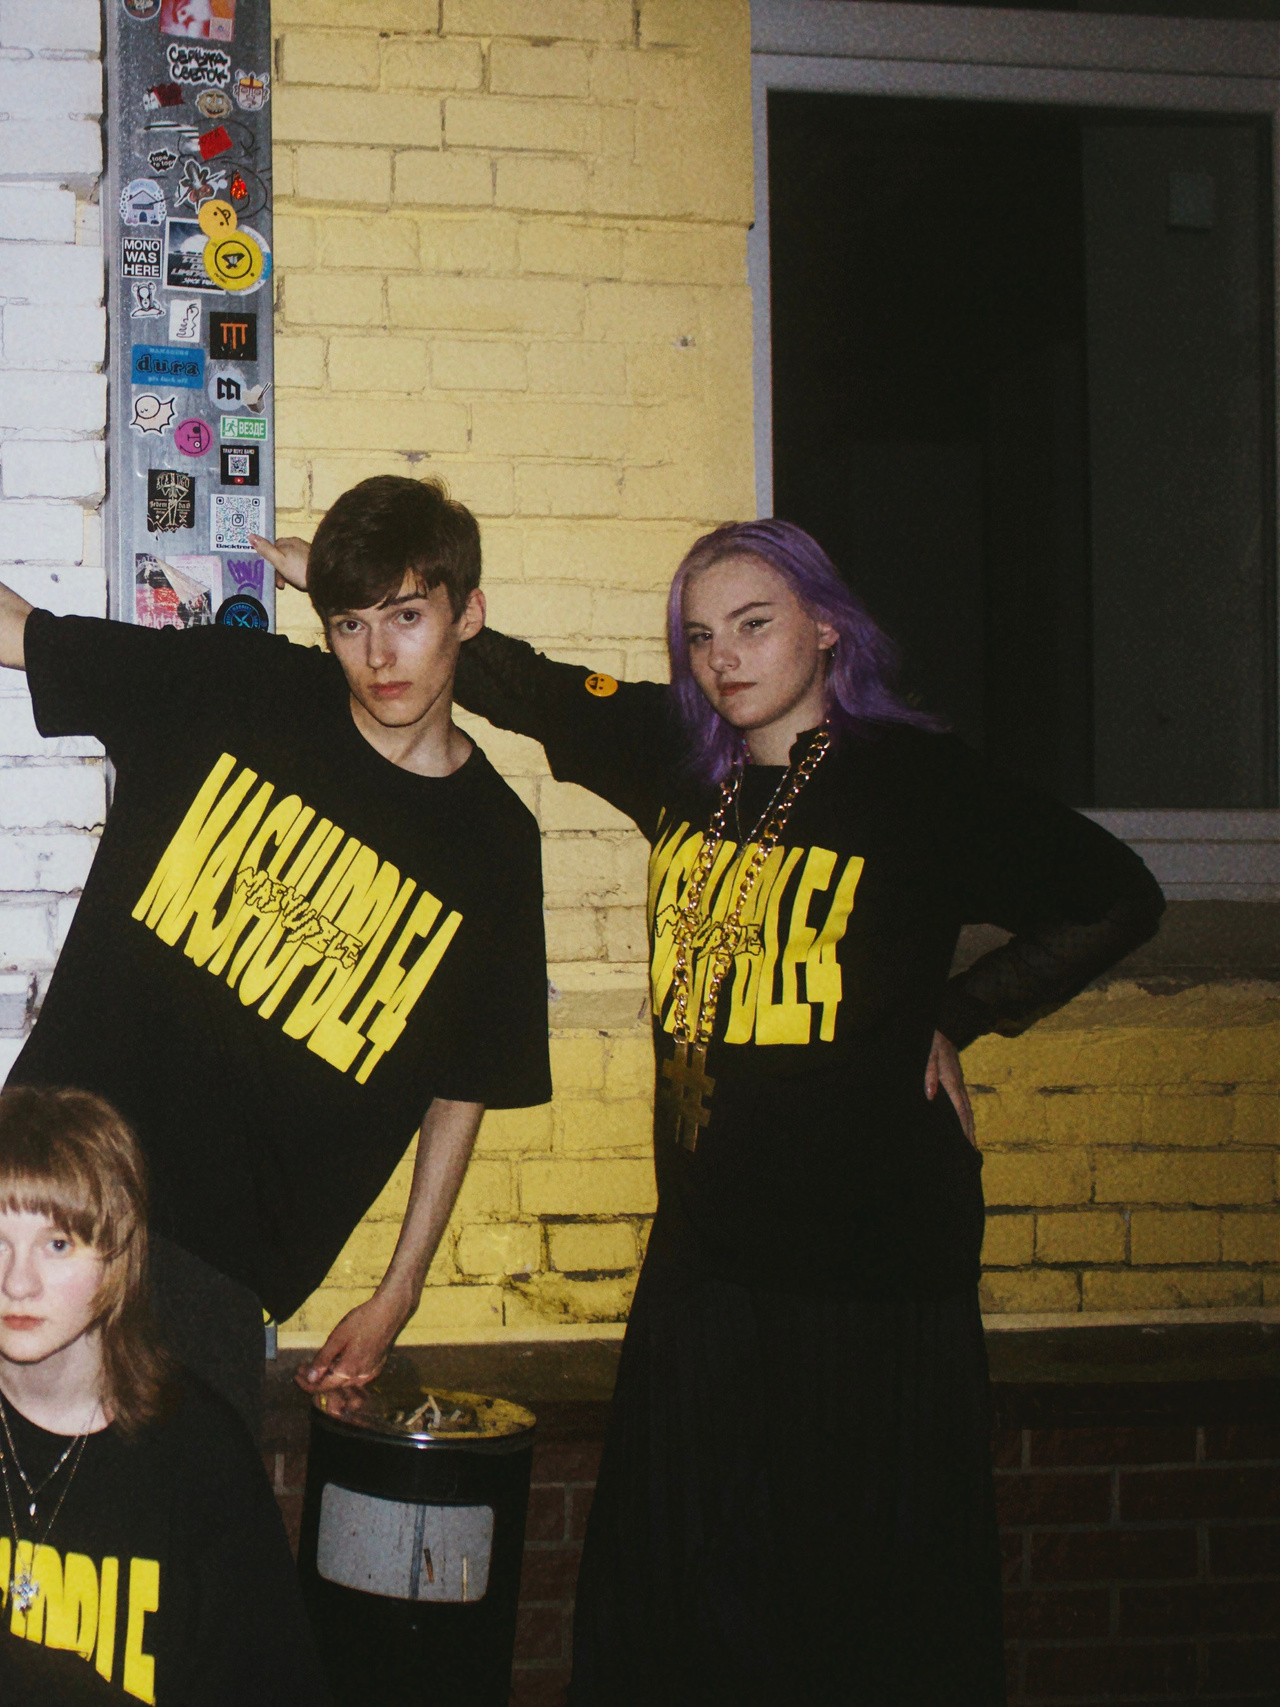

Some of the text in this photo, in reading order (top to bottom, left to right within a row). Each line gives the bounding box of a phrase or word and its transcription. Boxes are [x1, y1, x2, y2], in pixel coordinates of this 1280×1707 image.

[124, 239, 160, 251] MONO
[125, 251, 157, 264] WAS
[124, 263, 160, 277] HERE
[137, 354, 200, 376] dura
[238, 421, 265, 437] ВЕЗДЕ
